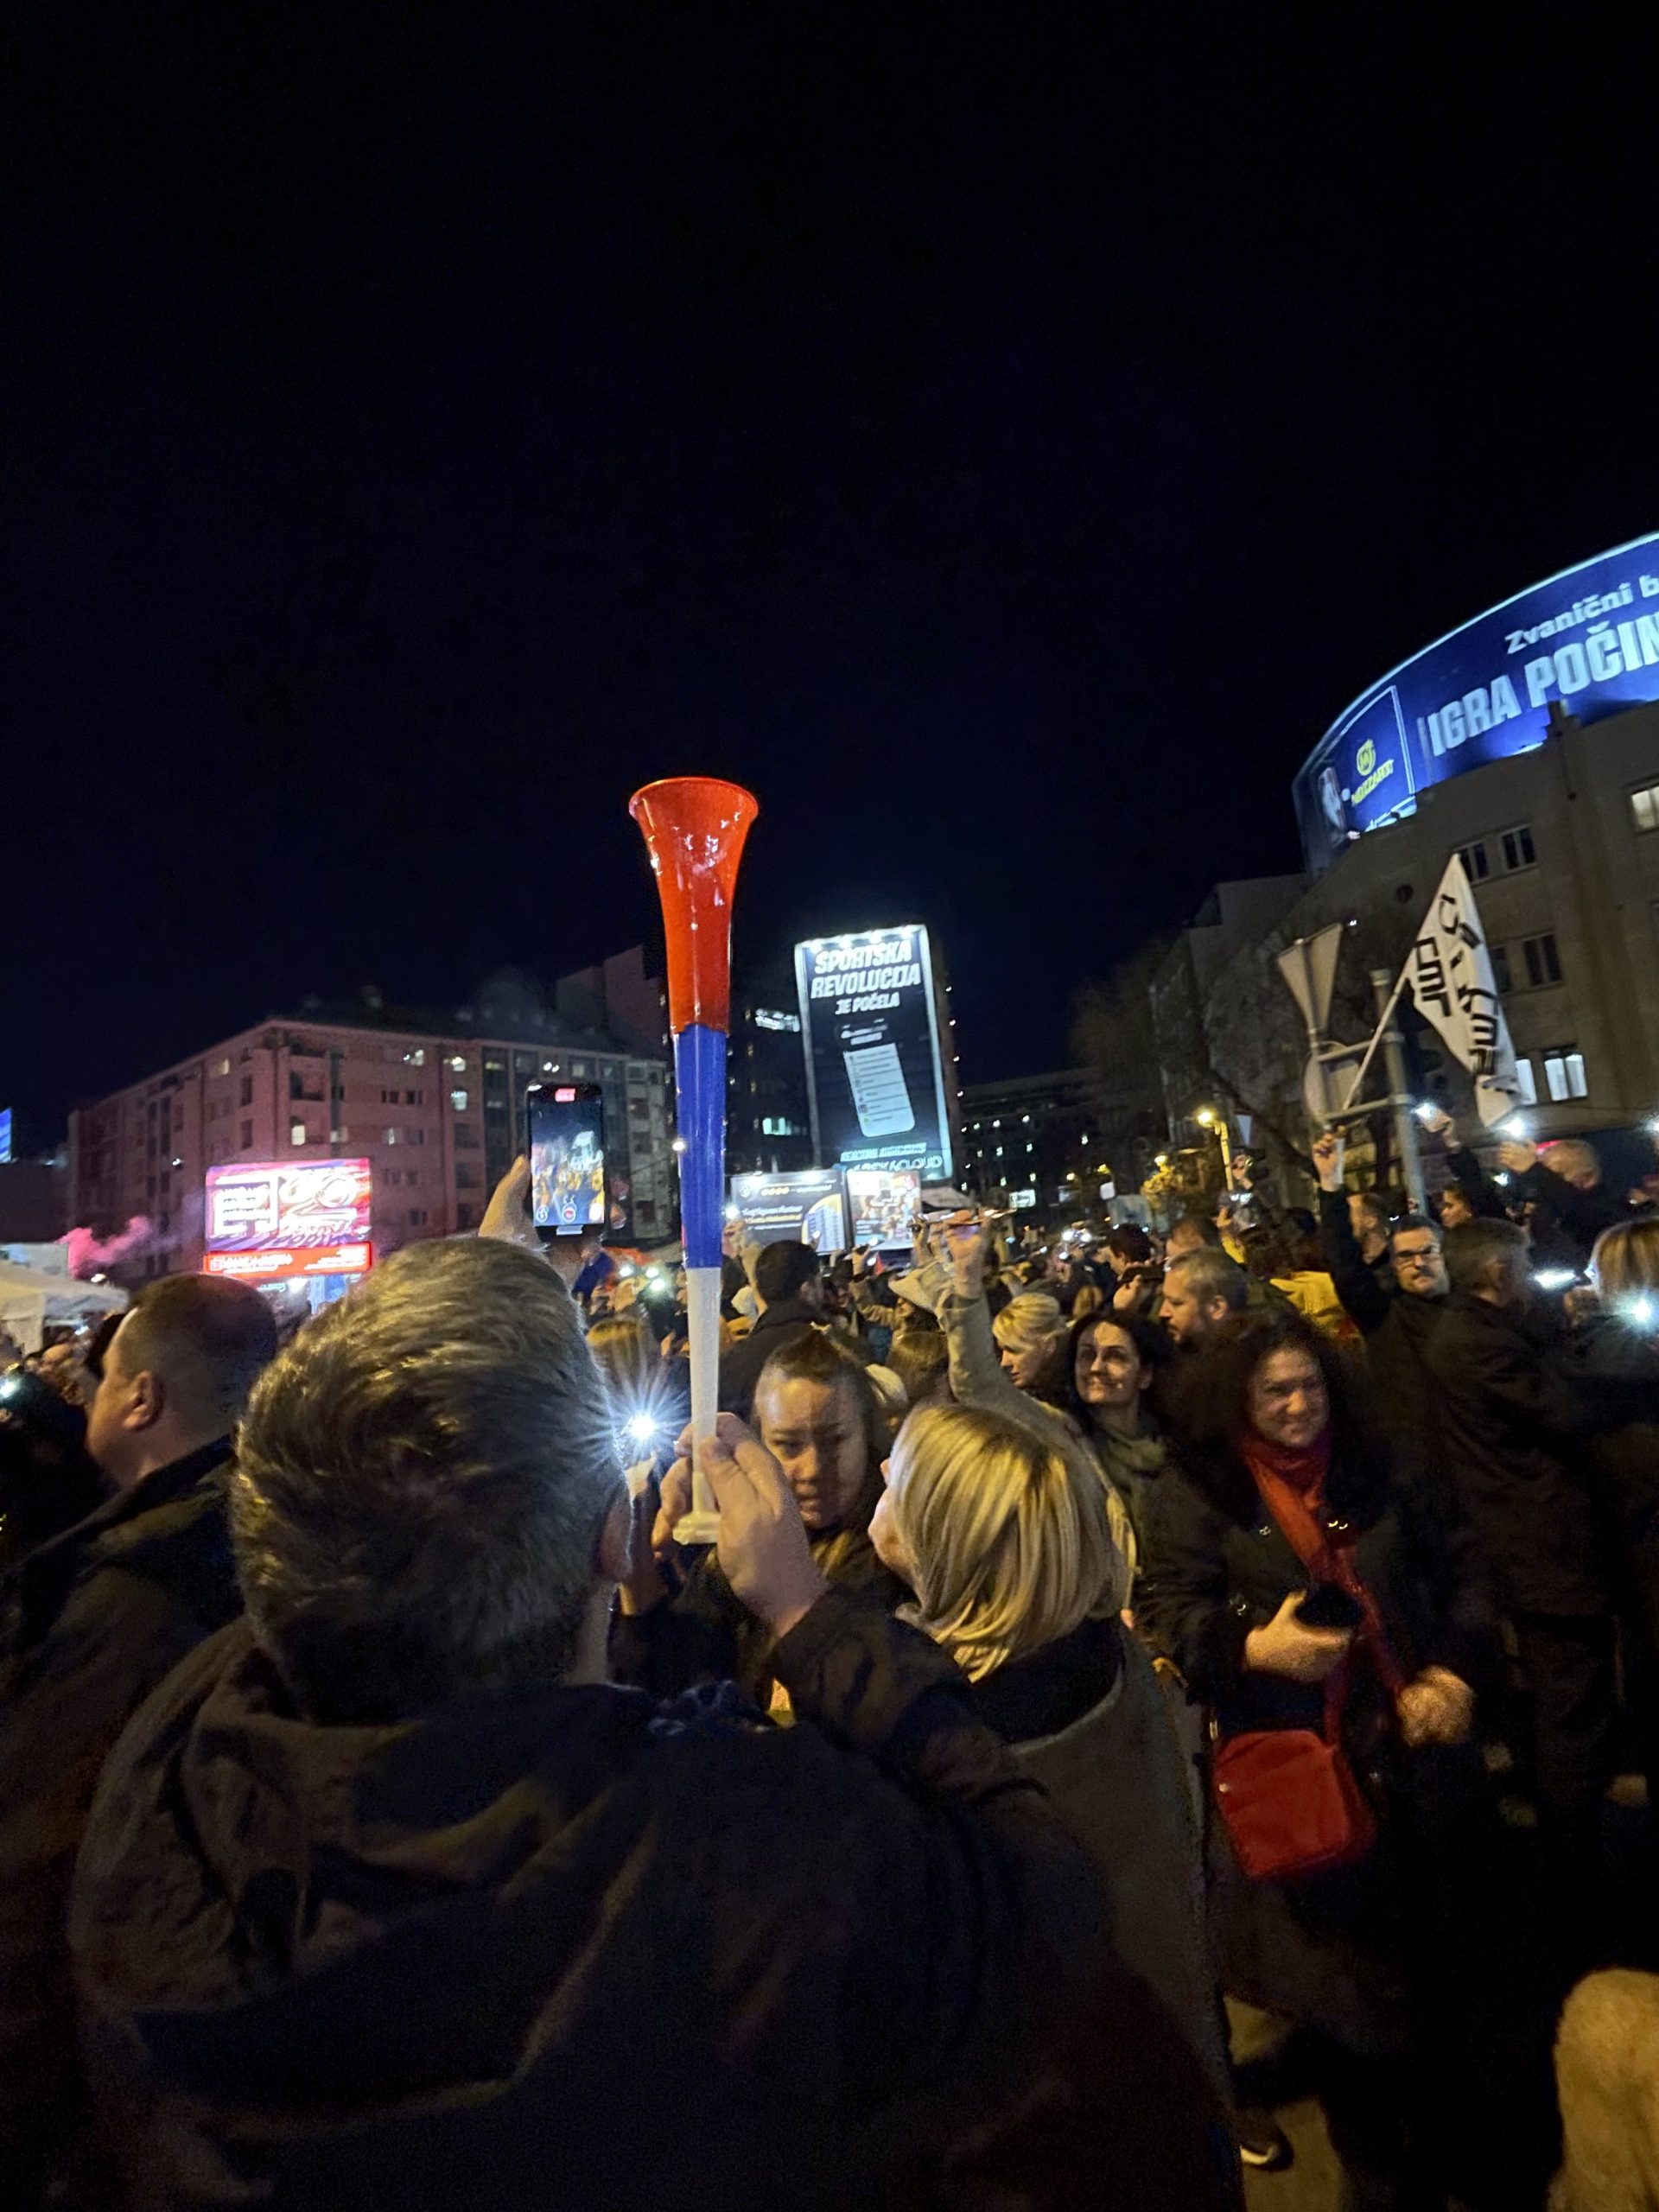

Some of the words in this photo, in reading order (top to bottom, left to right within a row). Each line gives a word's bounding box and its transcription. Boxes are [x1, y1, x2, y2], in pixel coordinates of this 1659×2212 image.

[1504, 582, 1634, 654] Zvanični
[1427, 675, 1522, 757] IGRA
[815, 939, 912, 974] SPORTSKA
[810, 963, 921, 999] REVOLUCIJA
[835, 998, 852, 1015] JE
[852, 990, 900, 1013] POČELA
